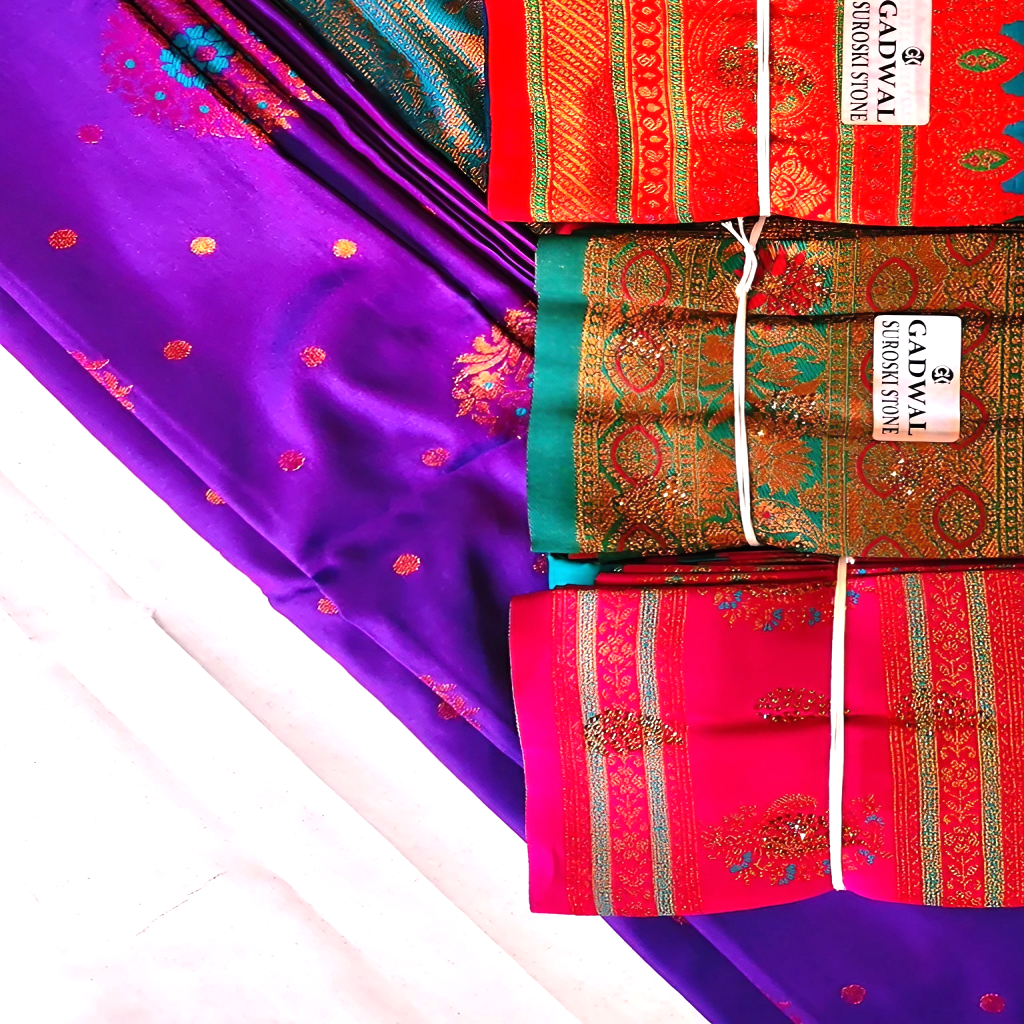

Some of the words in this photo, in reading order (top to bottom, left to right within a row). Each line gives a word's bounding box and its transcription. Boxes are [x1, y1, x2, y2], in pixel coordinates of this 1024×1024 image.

[852, 2, 871, 68] SUROSKI
[877, 0, 899, 123] GADWAL
[849, 72, 868, 122] STONE
[882, 321, 900, 386] SUROSKI
[907, 319, 927, 436] GADWAL
[881, 389, 899, 436] STONE
